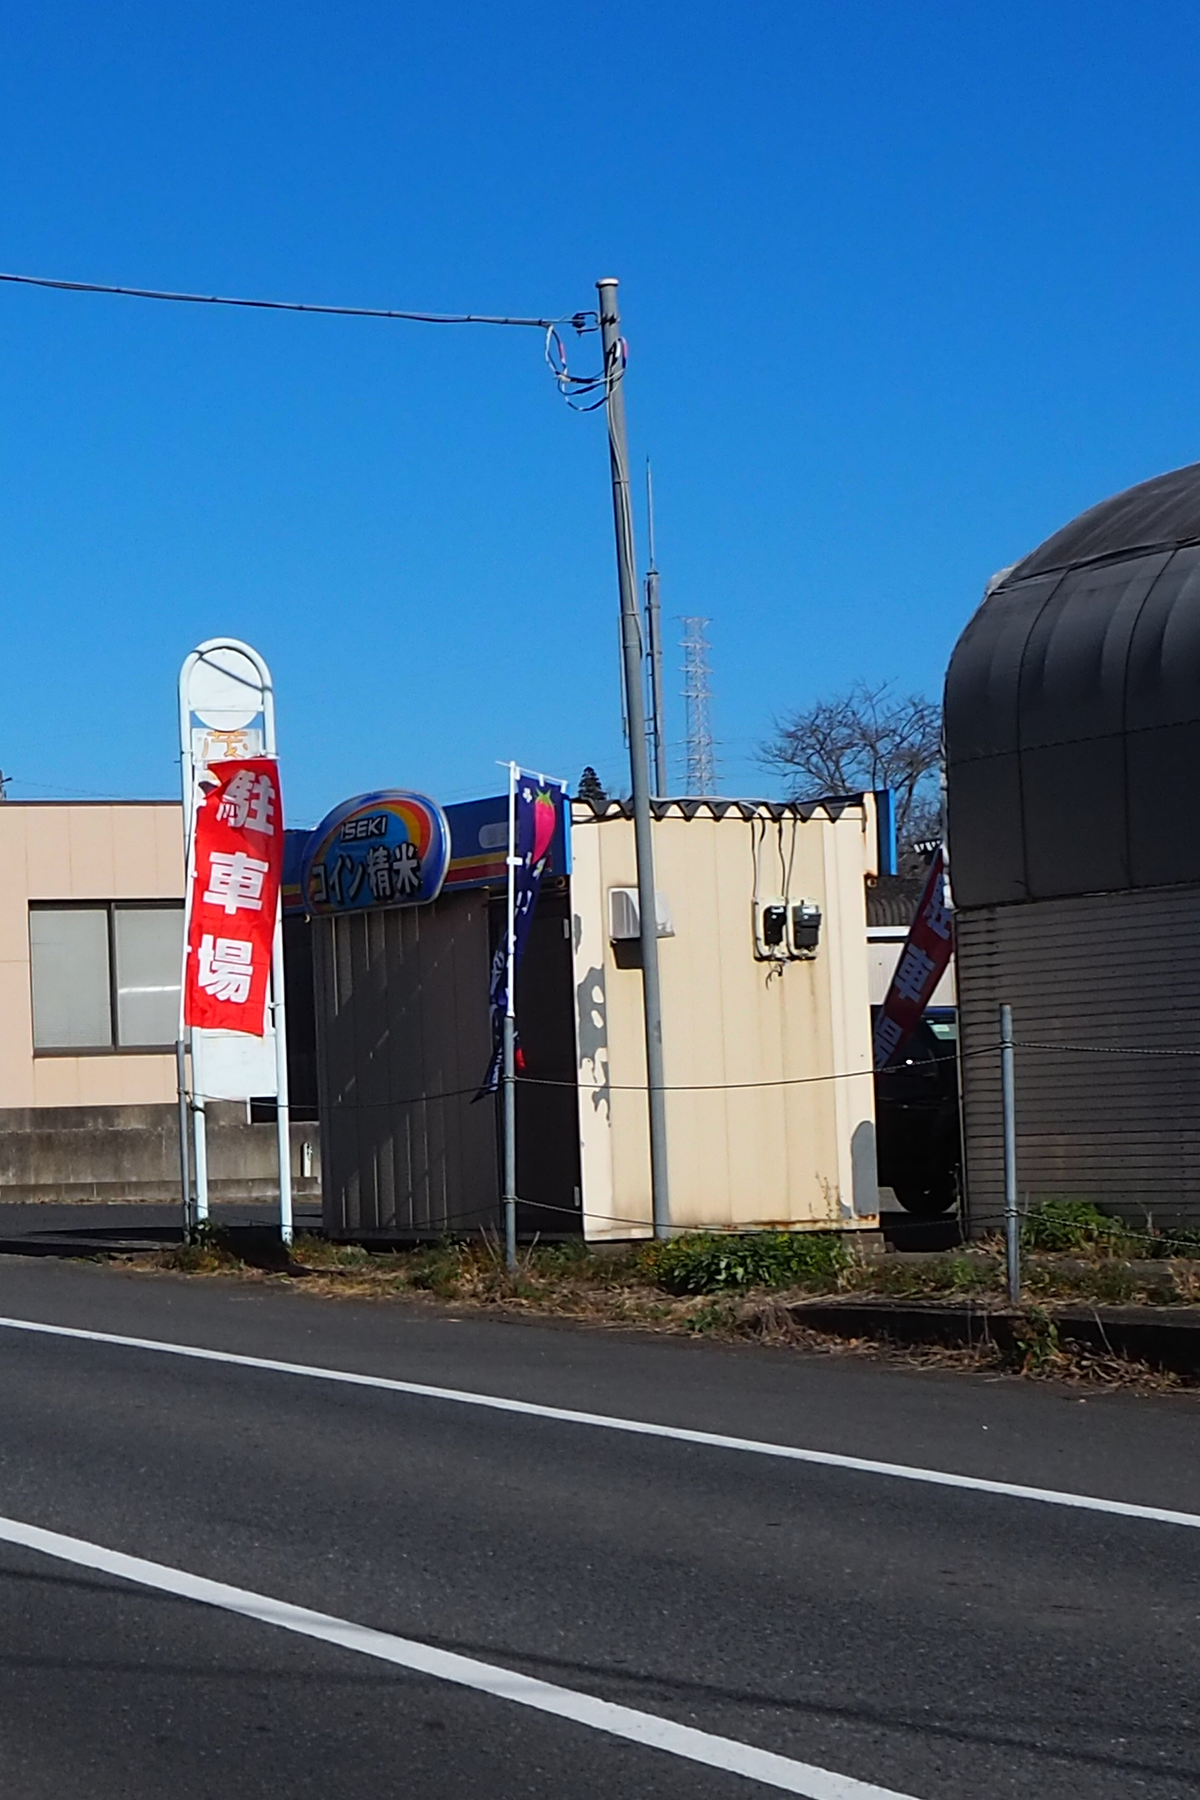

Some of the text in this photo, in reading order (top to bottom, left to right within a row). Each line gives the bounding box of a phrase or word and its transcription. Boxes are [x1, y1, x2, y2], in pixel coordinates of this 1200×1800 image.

[340, 816, 388, 841] ISEKI
[198, 770, 276, 1004] 駐車場
[311, 842, 421, 902] コイン精米
